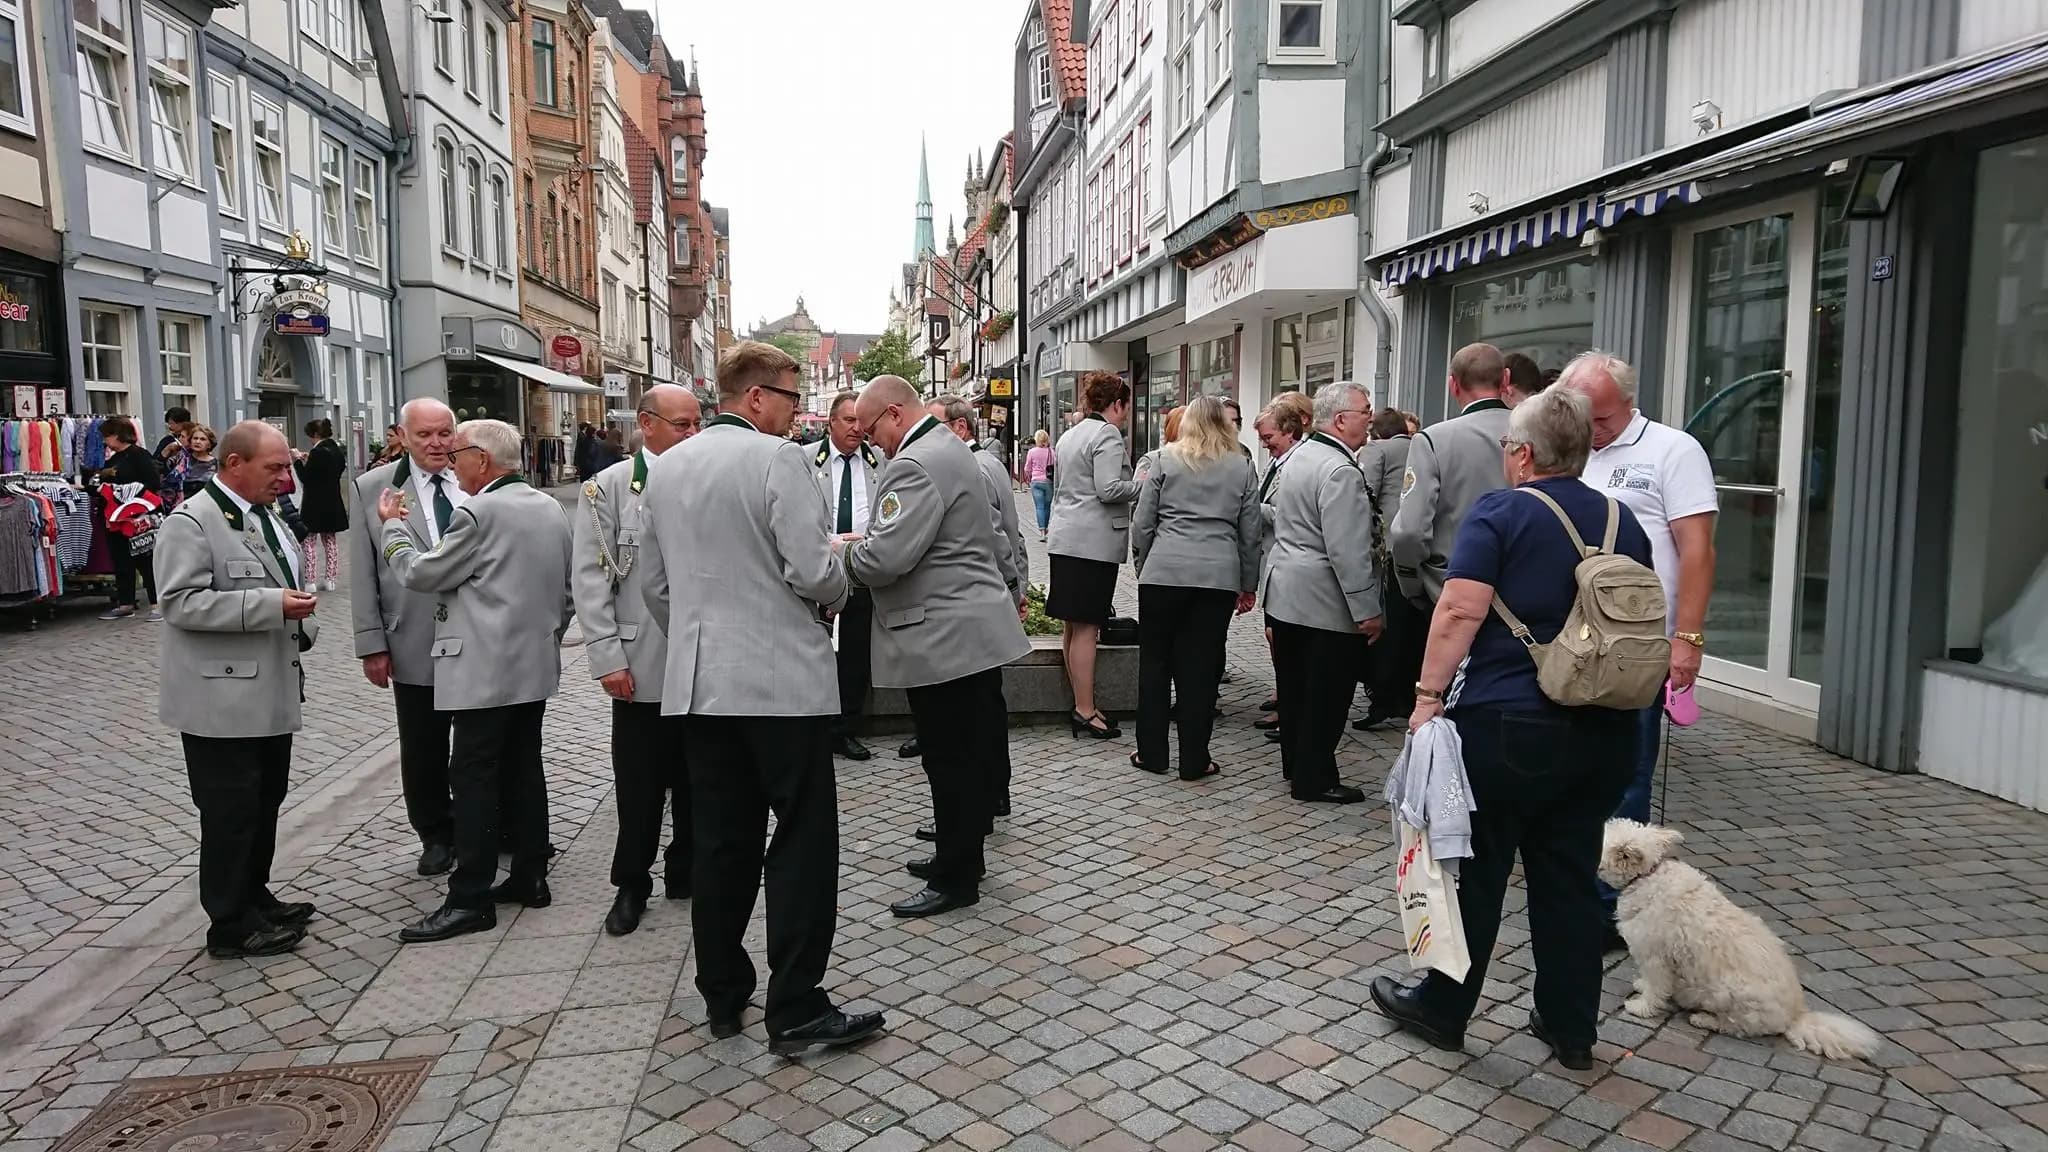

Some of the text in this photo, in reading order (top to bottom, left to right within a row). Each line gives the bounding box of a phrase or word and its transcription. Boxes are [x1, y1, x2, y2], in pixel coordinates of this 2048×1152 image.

[1875, 259, 1889, 276] 23
[278, 291, 324, 306] Zur Krone
[21, 400, 31, 411] 4
[50, 403, 58, 415] 5
